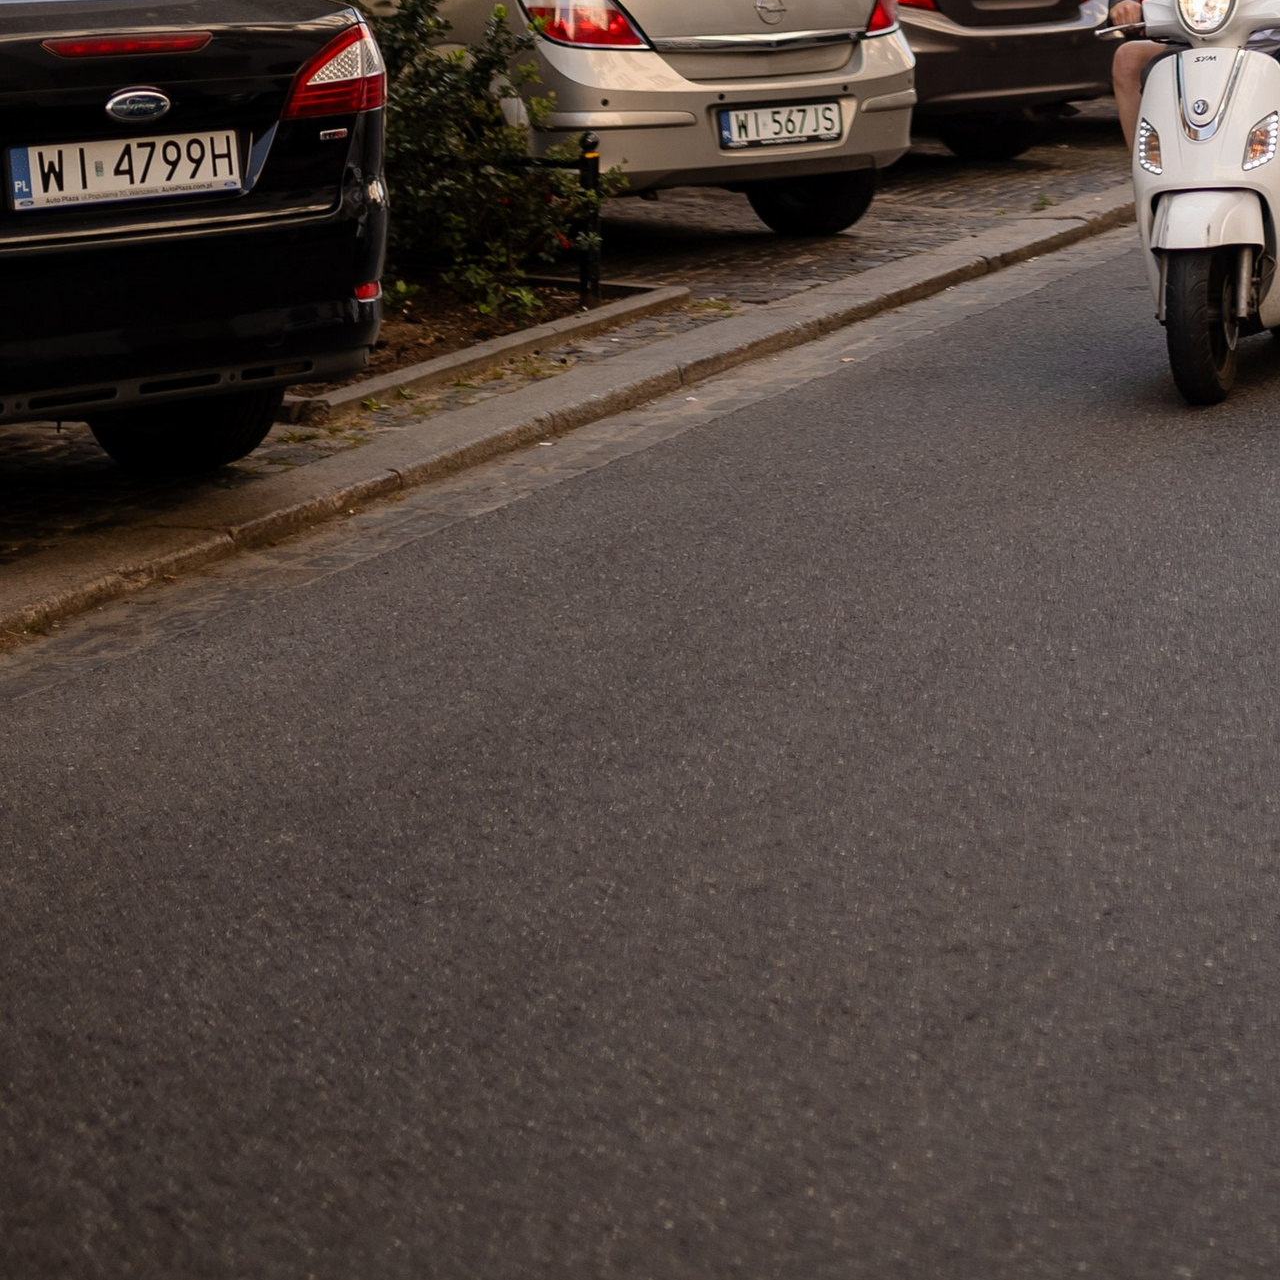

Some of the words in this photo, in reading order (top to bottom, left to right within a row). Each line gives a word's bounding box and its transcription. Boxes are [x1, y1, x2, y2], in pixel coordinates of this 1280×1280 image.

[1194, 55, 1217, 63] SYM
[735, 112, 760, 138] WI
[771, 107, 835, 135] 567JS
[37, 148, 88, 193] WI
[113, 135, 234, 185] 4799H
[14, 180, 30, 193] PL
[46, 196, 61, 204] Auto
